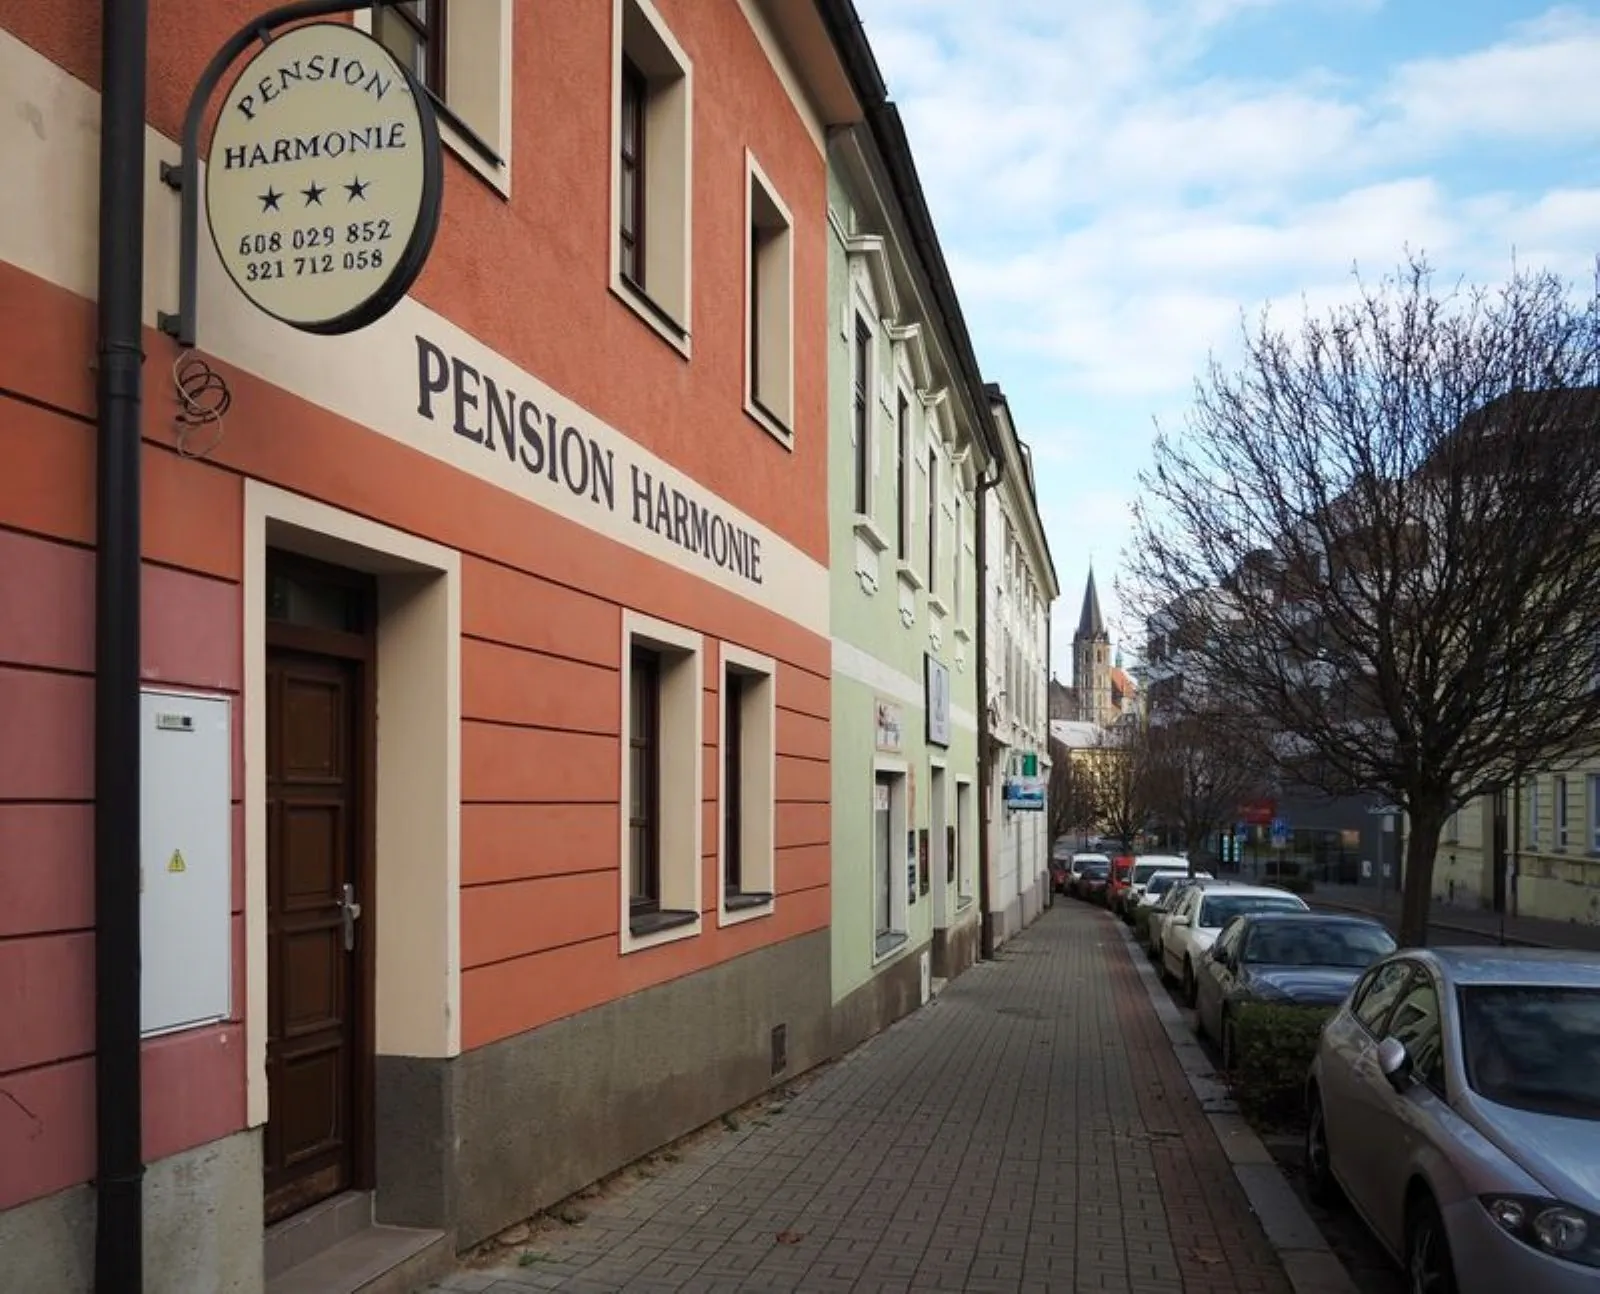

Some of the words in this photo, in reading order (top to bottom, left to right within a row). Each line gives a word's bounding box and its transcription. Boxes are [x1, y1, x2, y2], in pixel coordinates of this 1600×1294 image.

[237, 54, 391, 120] PENSION
[223, 122, 406, 170] HARMONIE
[239, 232, 283, 256] 608
[292, 226, 335, 250] 029
[346, 220, 392, 243] 852
[246, 258, 285, 281] 321
[294, 254, 335, 275] 712
[342, 249, 383, 271] 058
[415, 335, 615, 511] PENSION
[630, 463, 763, 584] HARMONIE
